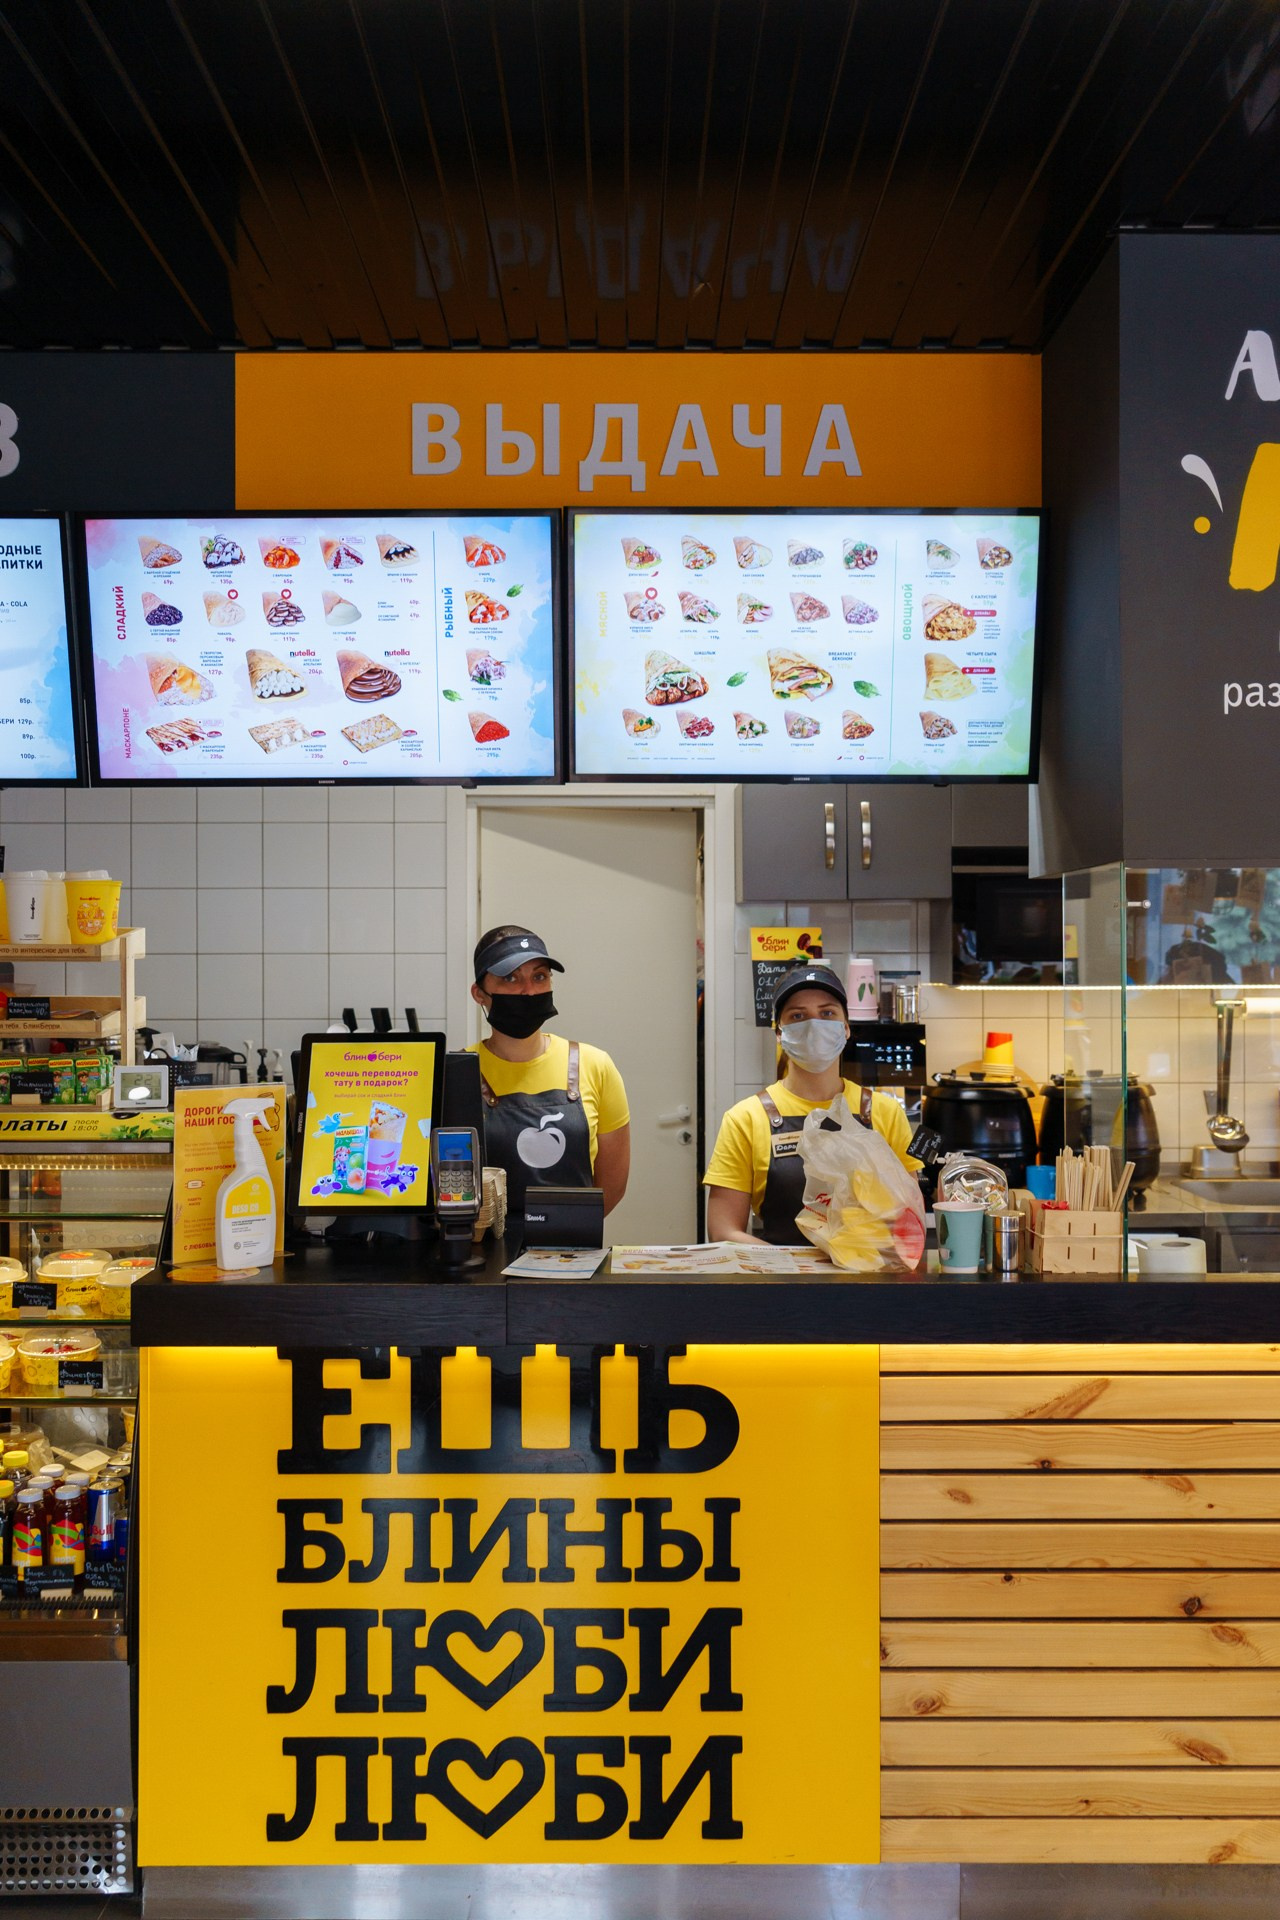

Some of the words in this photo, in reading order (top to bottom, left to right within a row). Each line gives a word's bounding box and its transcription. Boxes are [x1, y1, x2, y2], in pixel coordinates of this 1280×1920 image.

[411, 402, 863, 492] ВЫДАЧА
[0, 559, 43, 570] ПИТКИ
[112, 586, 127, 640] СЛАДКИЙ
[441, 587, 454, 638] РЫБНЫЙ
[596, 591, 608, 637] МЯСНОЙ
[901, 583, 914, 641] ОВОЩНОЙ
[289, 649, 316, 657] nutella
[384, 649, 411, 657] nutella
[17, 718, 34, 726] 129р.
[122, 708, 131, 758] МАСКАРПОНЕ
[766, 936, 790, 945] блин
[71, 946, 87, 954] тебя.
[762, 944, 787, 954] бери
[344, 1051, 367, 1061] блин
[377, 1051, 402, 1063] бери
[361, 1070, 419, 1078] переводное
[334, 1080, 354, 1088] тату
[363, 1079, 409, 1087] подарок?
[184, 1106, 223, 1118] ДОРОГИ
[184, 1116, 215, 1128] НАШИ
[217, 1116, 236, 1125] ГОС
[188, 1242, 216, 1250] ЛЮБОВЬ
[277, 1344, 741, 1475] ЕШЬ
[276, 1497, 741, 1583] БЛИНЫ
[85, 1561, 105, 1573] Red
[266, 1607, 744, 1714] ЛЮБИ
[266, 1735, 744, 1842] ЛЮБИ
